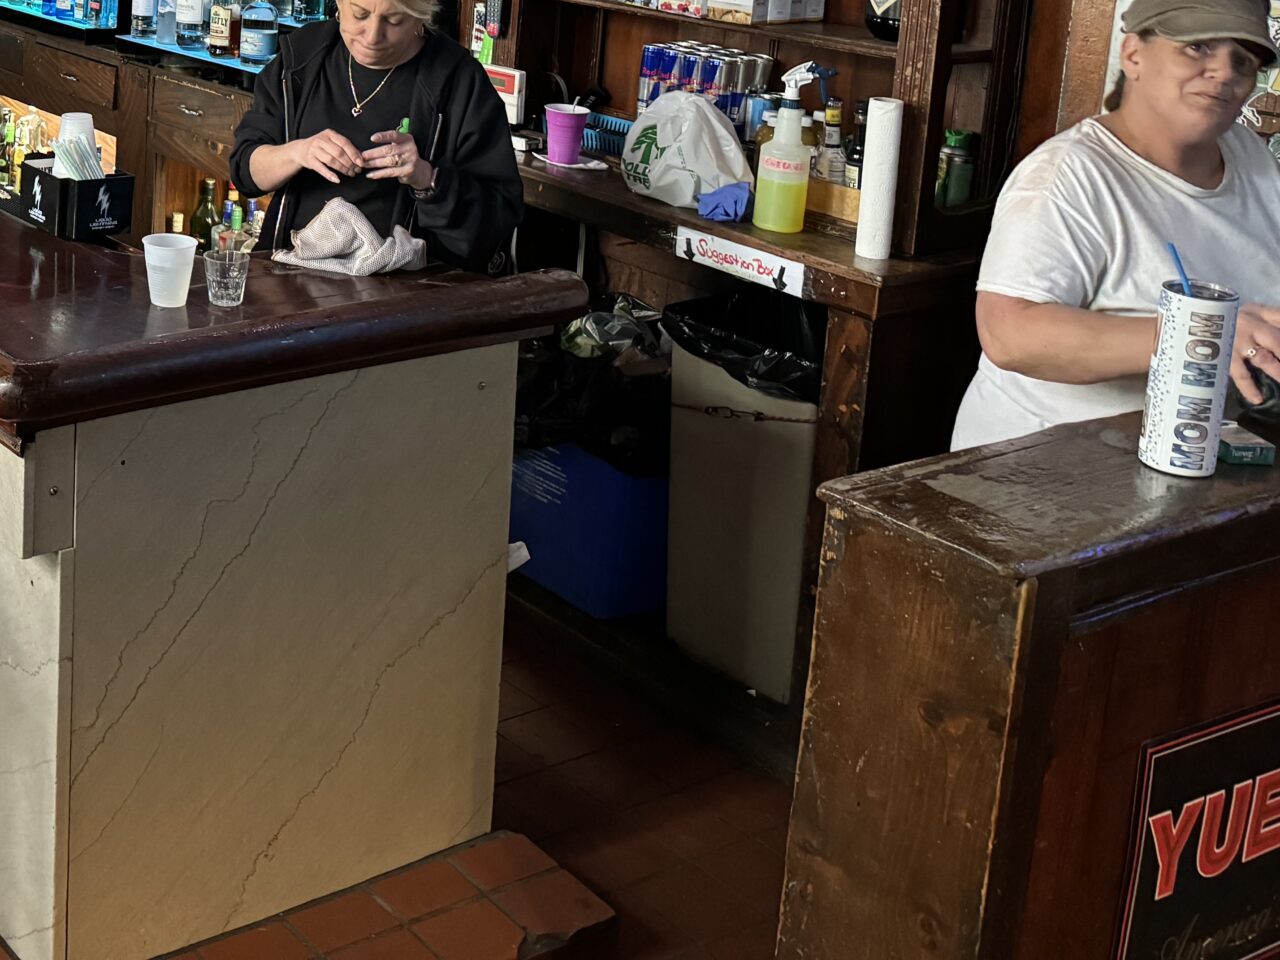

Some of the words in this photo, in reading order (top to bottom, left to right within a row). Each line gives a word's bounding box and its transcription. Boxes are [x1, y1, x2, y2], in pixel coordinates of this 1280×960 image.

[696, 238, 754, 270] Suggestion
[753, 258, 774, 277] Box
[1181, 311, 1225, 388] MOM
[1170, 395, 1213, 471] MOM
